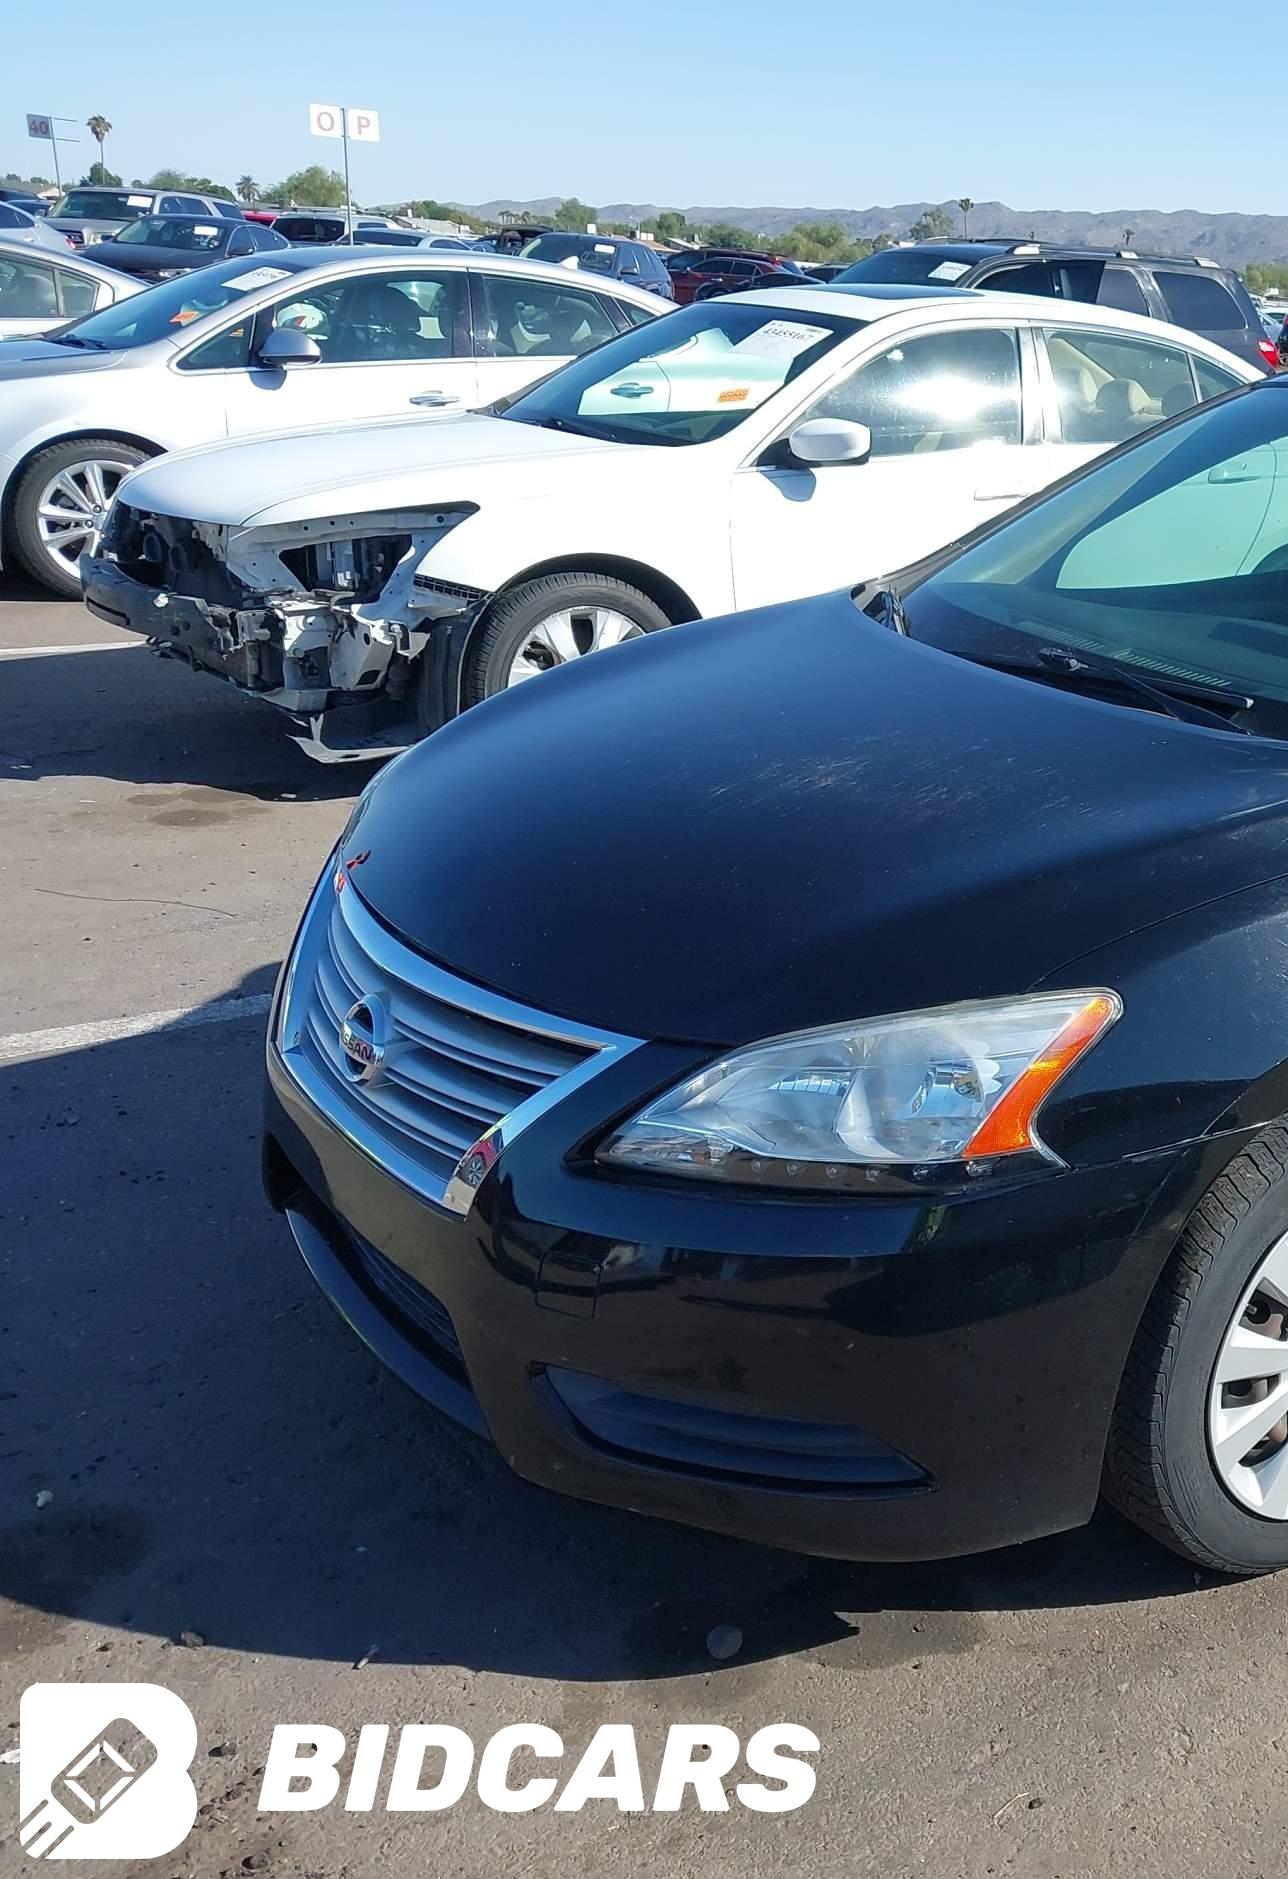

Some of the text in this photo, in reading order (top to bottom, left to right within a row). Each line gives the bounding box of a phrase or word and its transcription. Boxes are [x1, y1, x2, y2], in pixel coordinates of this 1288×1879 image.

[29, 120, 49, 135] 40
[317, 111, 335, 132] O
[357, 115, 371, 135] P
